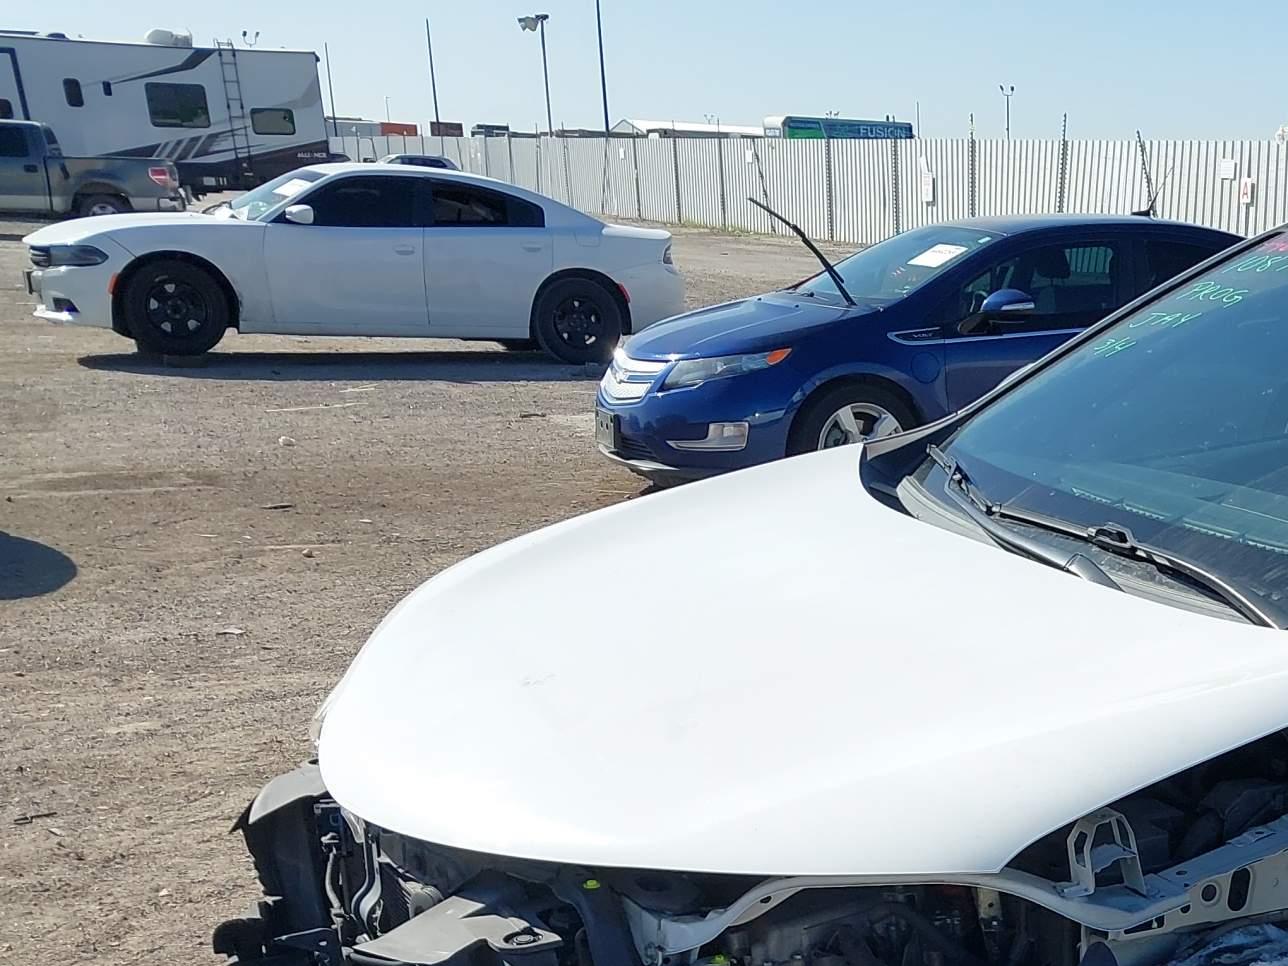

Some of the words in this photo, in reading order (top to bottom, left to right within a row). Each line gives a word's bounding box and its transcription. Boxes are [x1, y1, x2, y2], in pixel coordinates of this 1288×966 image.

[859, 125, 906, 138] FUSION
[1241, 182, 1249, 199] A
[1177, 281, 1249, 309] PROG
[1129, 311, 1203, 329] JAY
